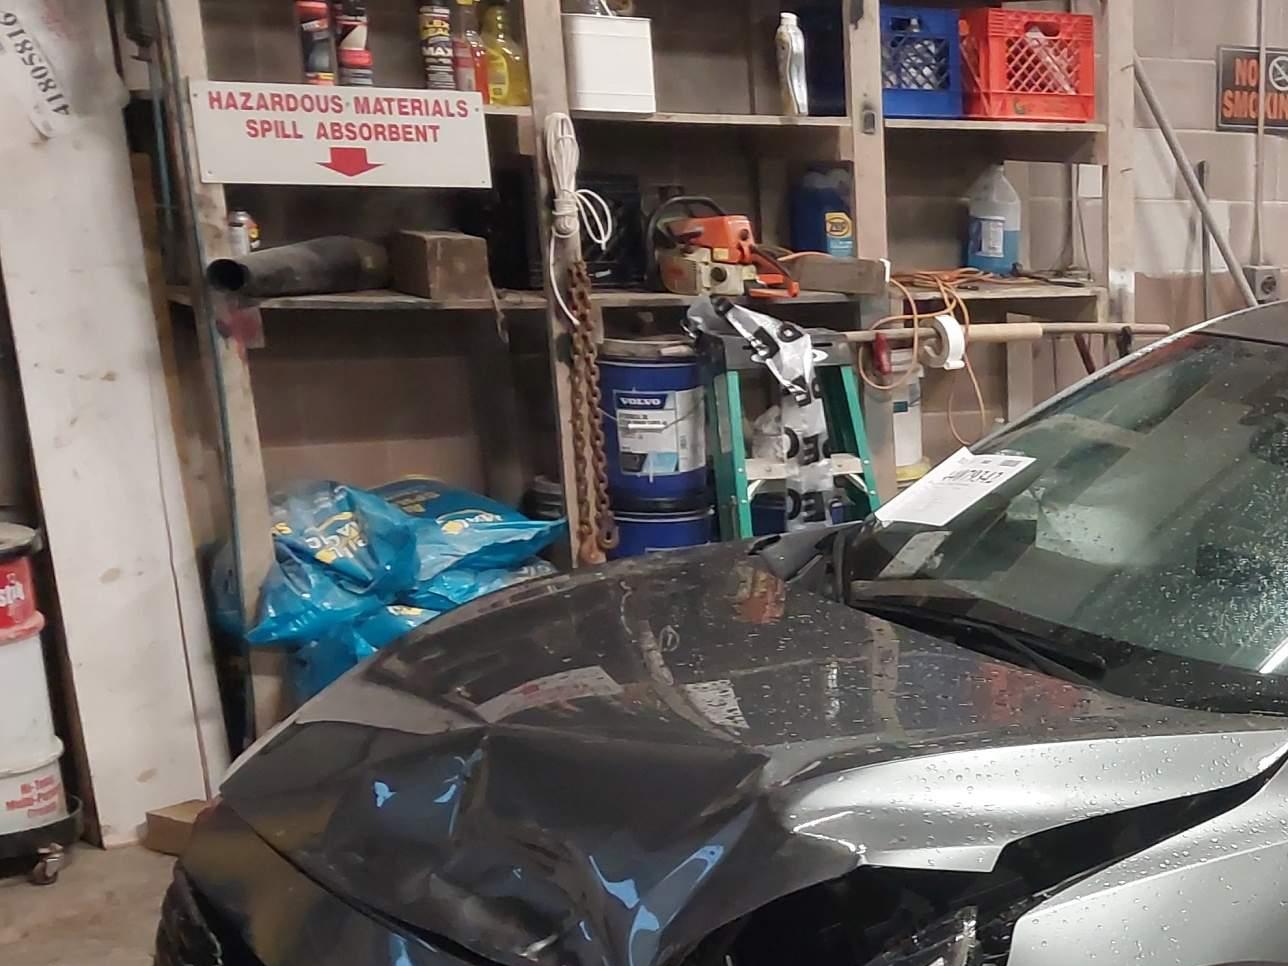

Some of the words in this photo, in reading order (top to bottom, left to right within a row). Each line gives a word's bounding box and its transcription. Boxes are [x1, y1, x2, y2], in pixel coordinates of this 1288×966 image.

[1234, 57, 1259, 87] NO
[208, 90, 343, 114] HAZARDOUS
[354, 96, 469, 118] MATERIALS
[245, 119, 304, 139] SPILL
[316, 121, 440, 143] ABSORBENT
[619, 397, 661, 406] VOLVO
